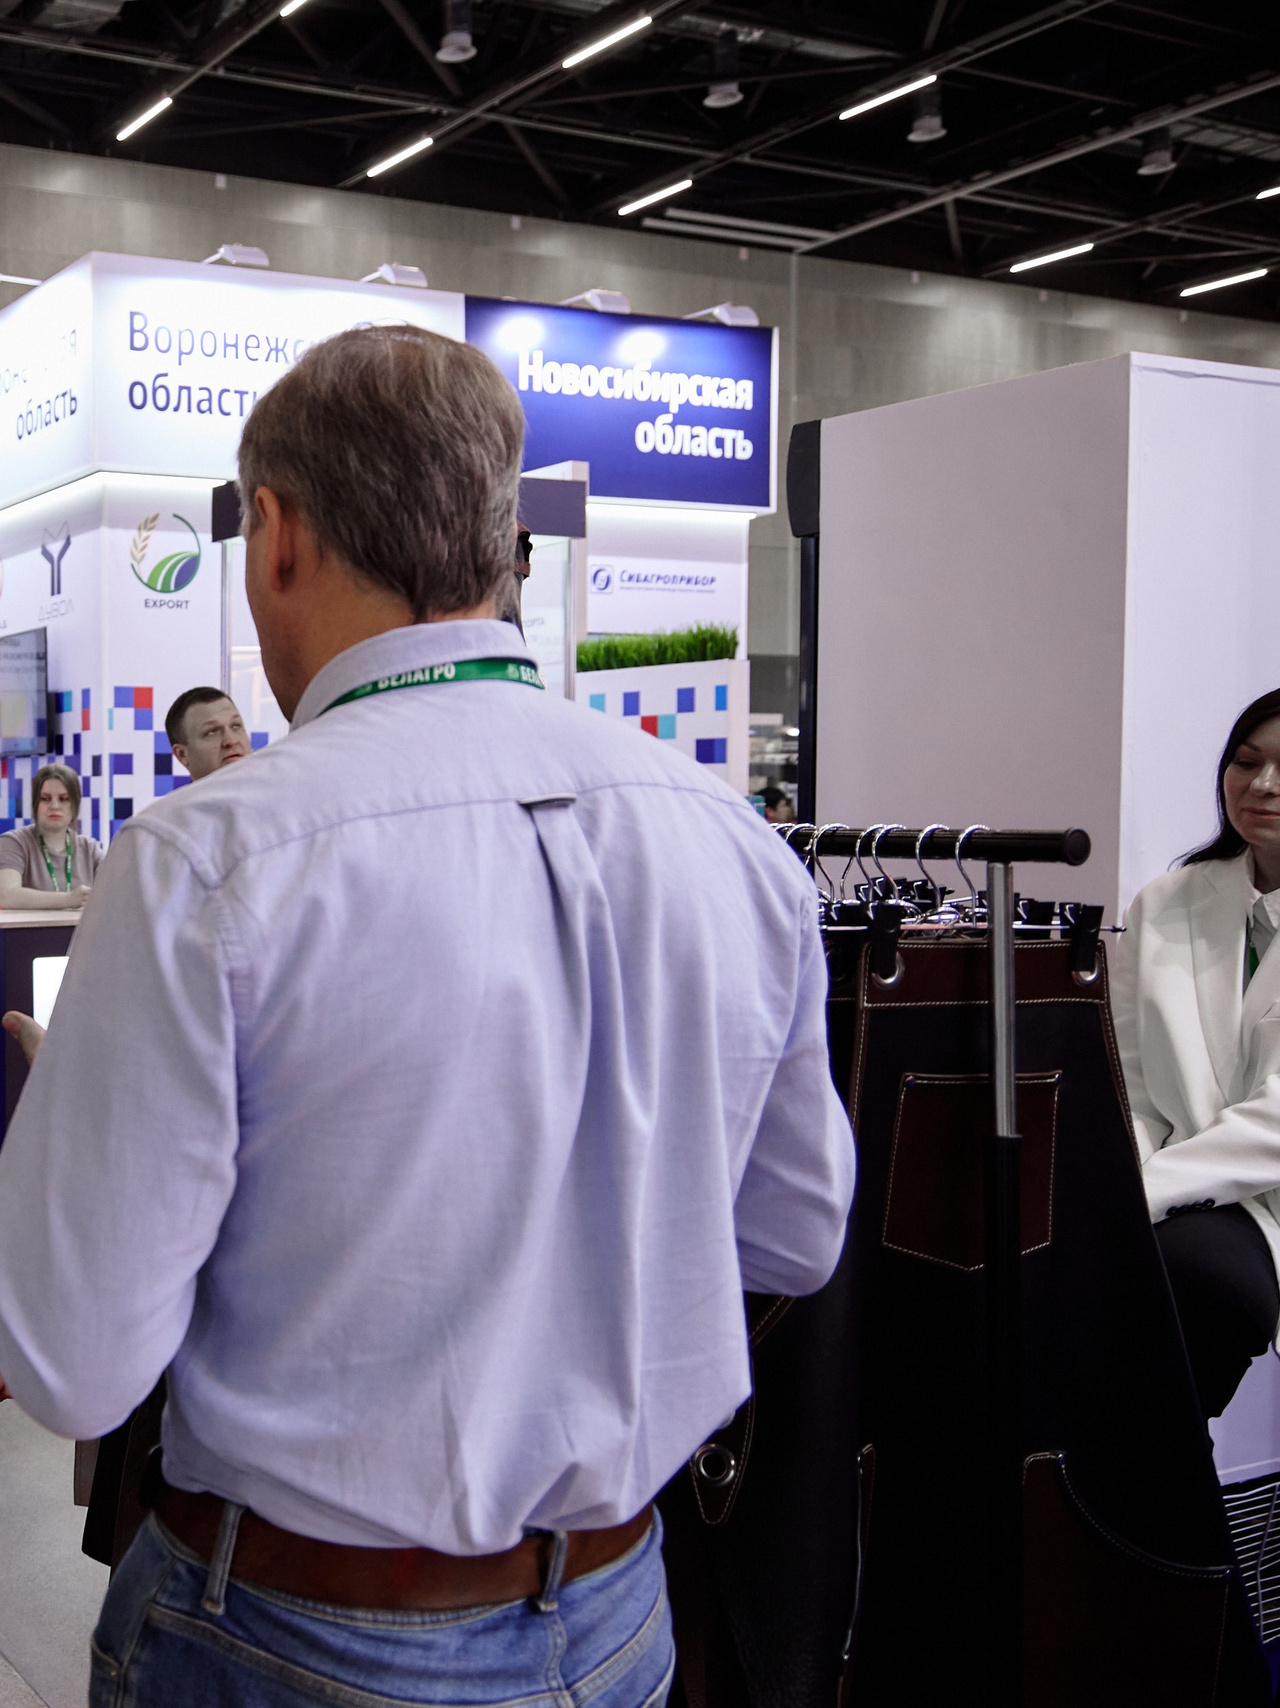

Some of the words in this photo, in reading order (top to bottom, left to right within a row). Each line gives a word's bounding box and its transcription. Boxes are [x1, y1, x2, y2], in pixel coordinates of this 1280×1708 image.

[128, 310, 306, 367] Воронежс
[518, 349, 754, 414] Новосибирская
[16, 388, 78, 440] область
[634, 412, 754, 461] область
[144, 598, 190, 610] EXPORT
